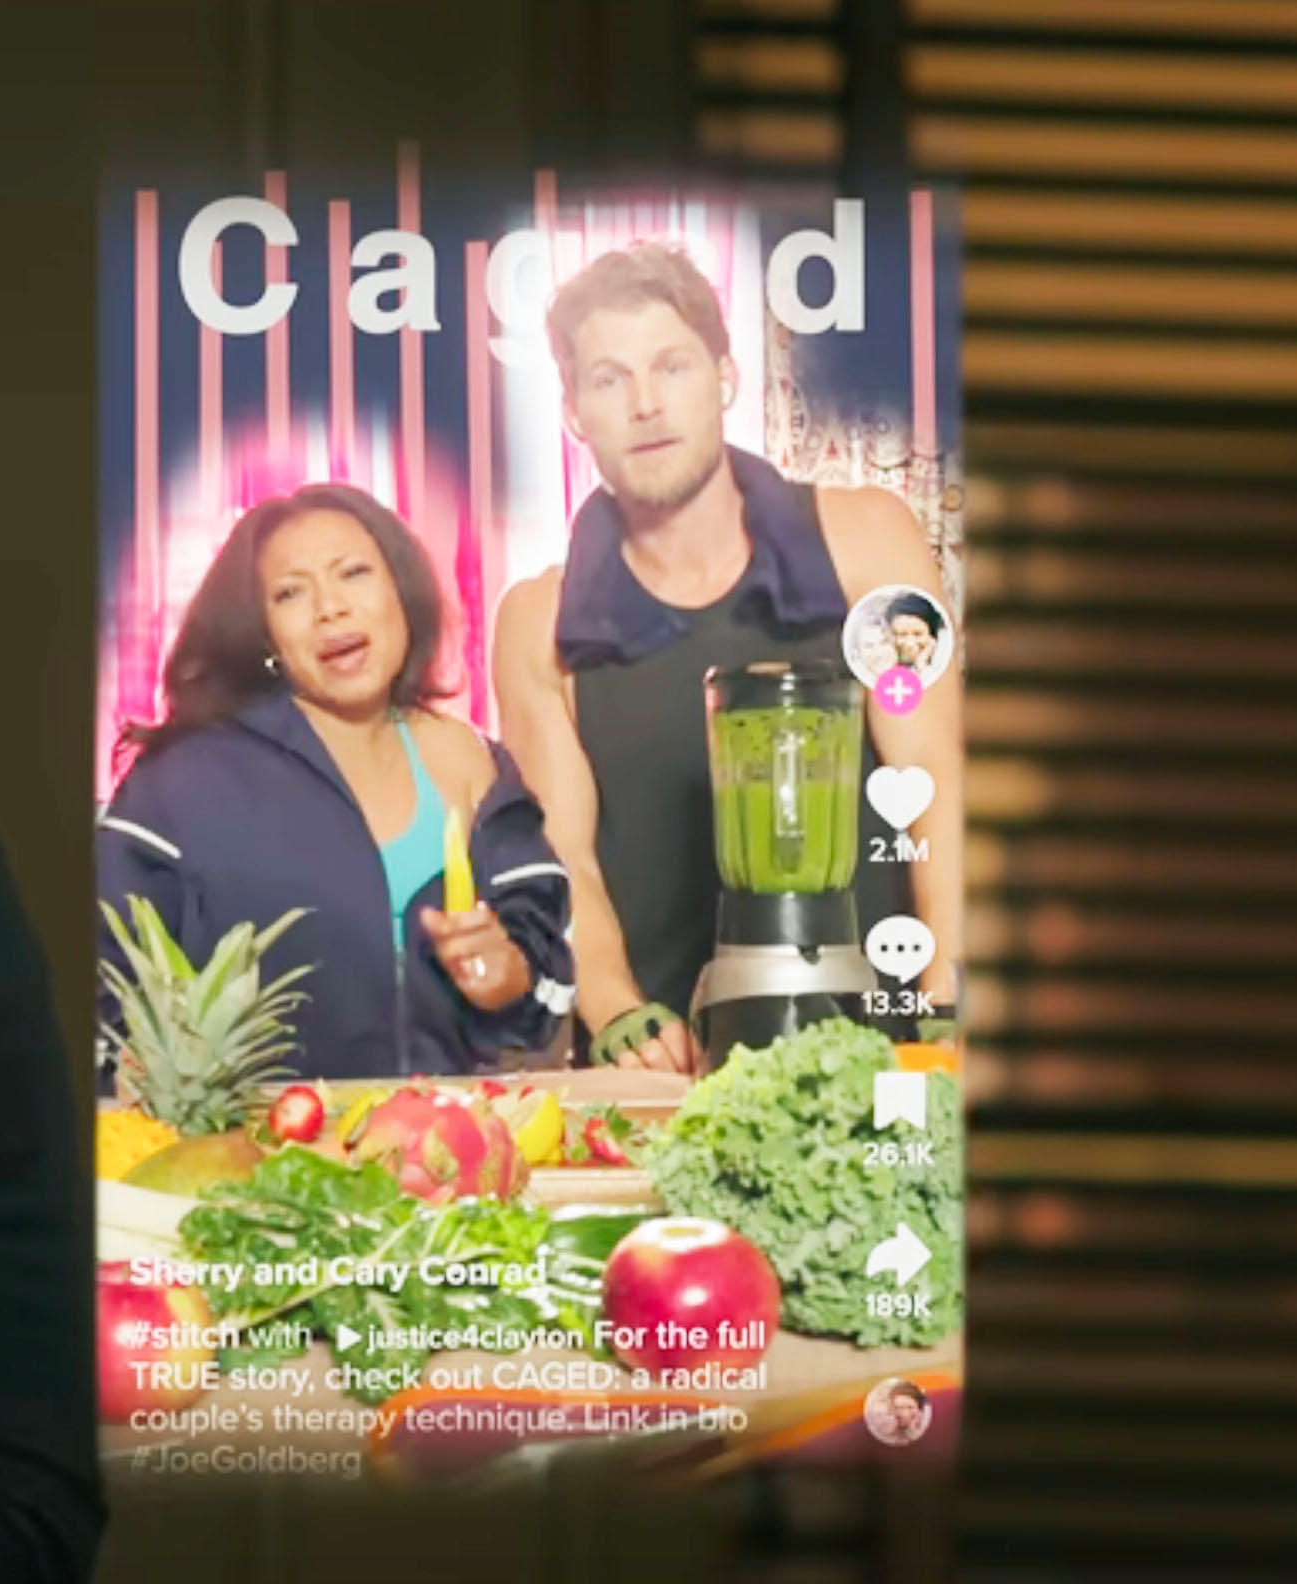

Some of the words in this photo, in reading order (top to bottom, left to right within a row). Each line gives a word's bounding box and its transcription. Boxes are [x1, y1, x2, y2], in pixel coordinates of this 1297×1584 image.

[178, 196, 865, 371] Cagd
[868, 837, 929, 862] 2.1M
[861, 991, 935, 1015] 13.3K
[863, 1142, 935, 1167] 26.1K
[130, 1257, 244, 1293] Sherry
[254, 1257, 317, 1286] and
[328, 1257, 410, 1293] Cary
[419, 1256, 546, 1286] Conrad
[866, 1294, 931, 1318] 189K
[130, 1321, 241, 1350] #stitch
[248, 1323, 312, 1350] with
[367, 1323, 583, 1356] justice4clayton
[594, 1321, 648, 1350] For
[656, 1321, 709, 1350] the
[717, 1320, 765, 1350] full
[130, 1361, 219, 1391] TRUE
[230, 1364, 315, 1397] story,
[325, 1361, 421, 1391] check
[430, 1365, 484, 1391] out
[492, 1361, 621, 1391] CAGED:
[631, 1369, 649, 1391] a
[661, 1361, 766, 1391] radical
[130, 1404, 263, 1437] couple's
[272, 1404, 396, 1437] therapy
[405, 1404, 573, 1437] technique.
[594, 1403, 646, 1432] Link
[661, 1403, 687, 1432] in
[698, 1403, 749, 1432] bio
[130, 1446, 362, 1479] #JoeGoldberg
